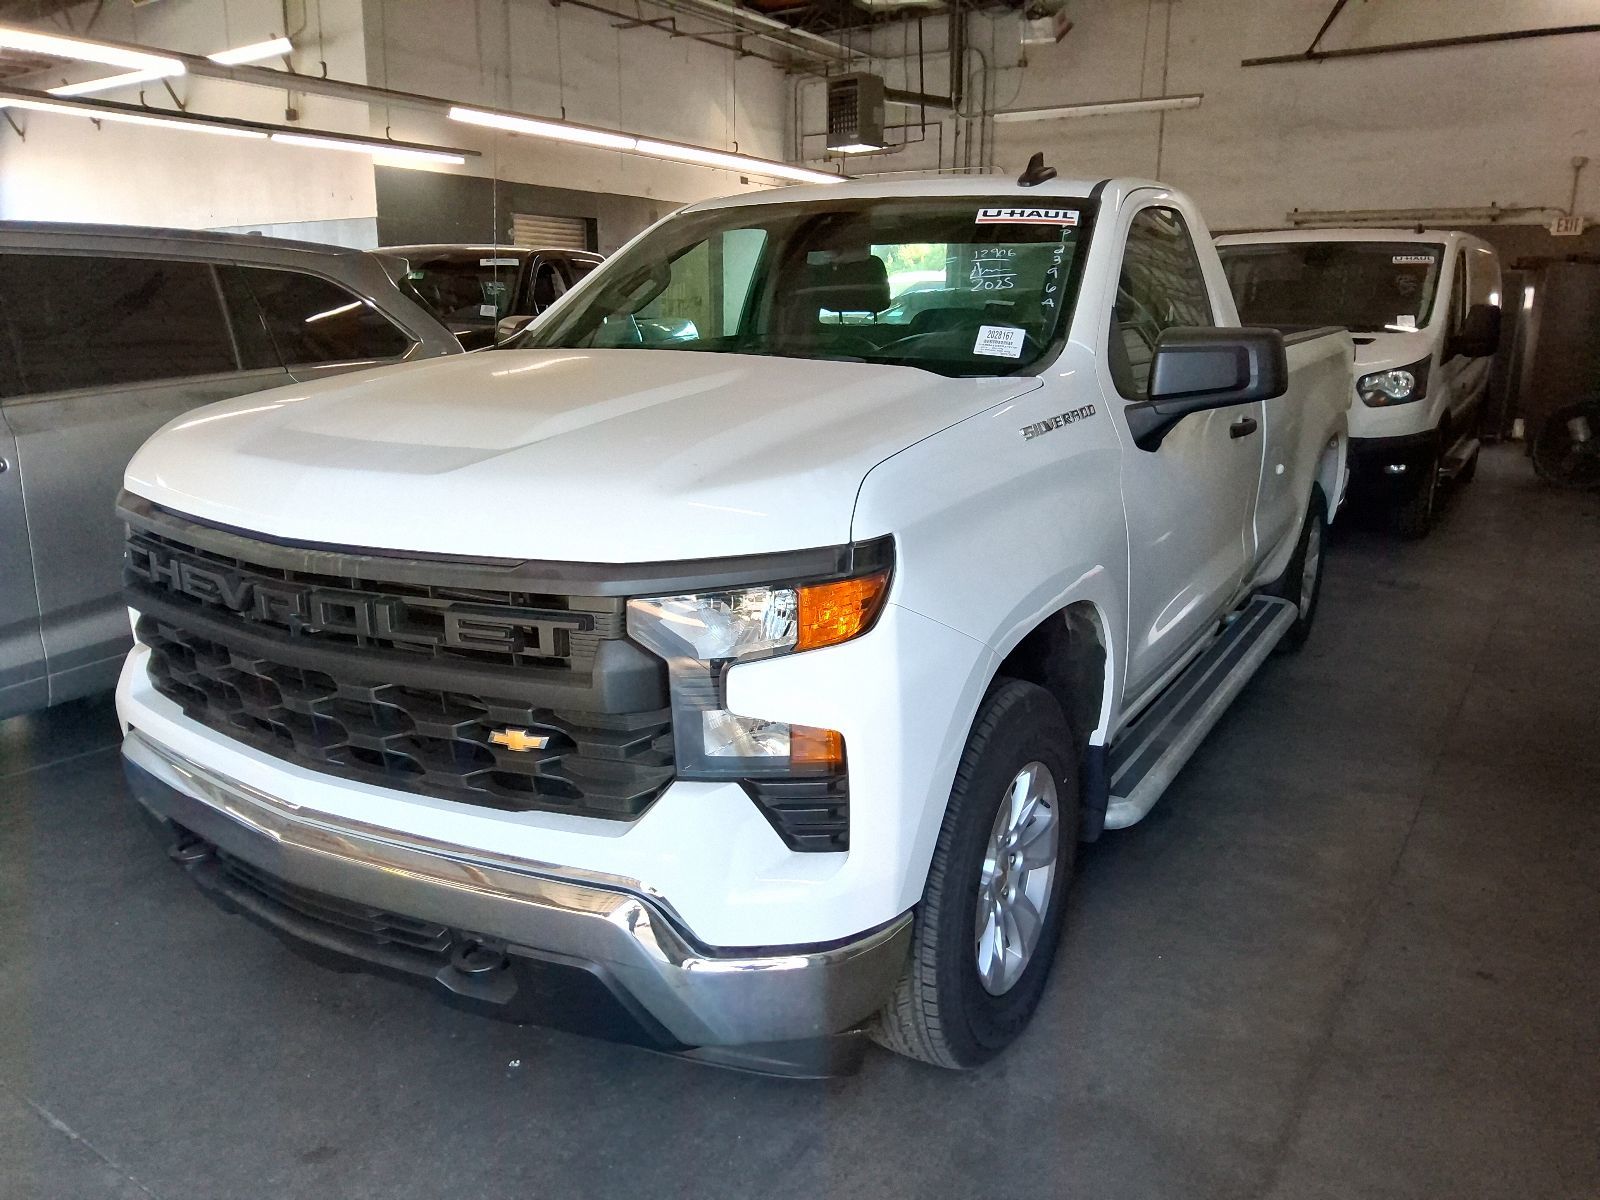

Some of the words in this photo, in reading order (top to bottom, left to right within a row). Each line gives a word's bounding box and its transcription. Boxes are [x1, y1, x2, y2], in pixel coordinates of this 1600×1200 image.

[982, 209, 1075, 220] U-HAUL
[1556, 217, 1580, 232] EXIT
[970, 277, 1014, 292] 2025
[1018, 404, 1097, 441] SILVERADO
[124, 540, 596, 659] CHEVROLET
